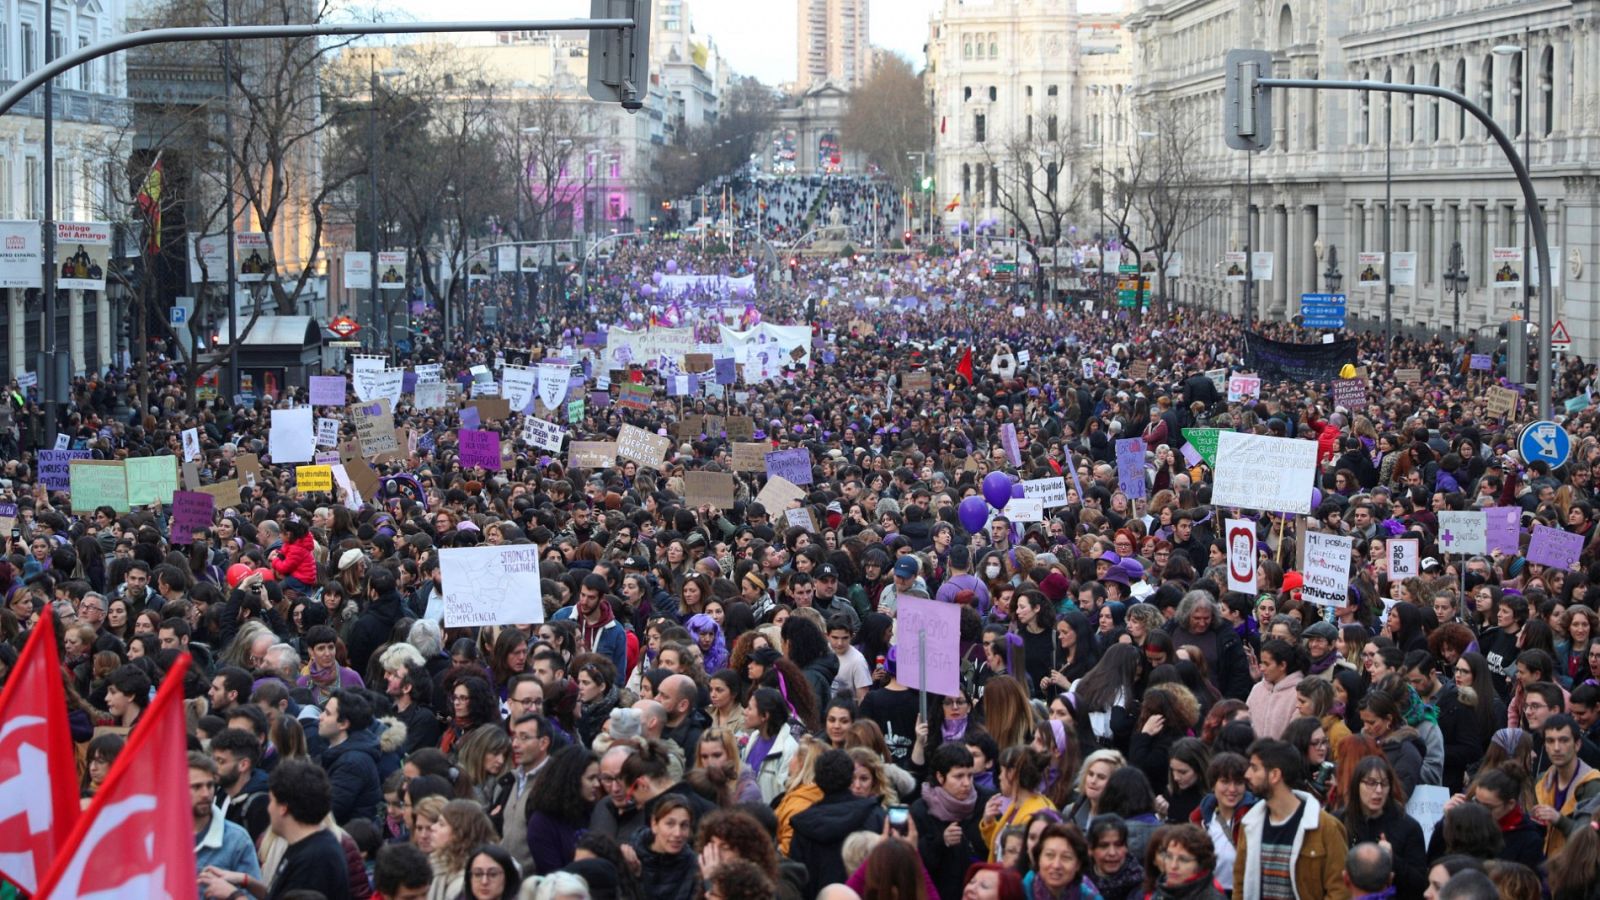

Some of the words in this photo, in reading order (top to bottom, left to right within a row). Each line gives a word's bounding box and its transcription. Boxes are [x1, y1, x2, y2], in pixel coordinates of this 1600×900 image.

[58, 223, 90, 232] Diálogo
[74, 231, 107, 240] Amargo
[174, 308, 185, 322] P
[624, 424, 651, 441] SOMOS
[621, 437, 656, 455] FUERTES
[40, 451, 53, 460] NO
[56, 452, 70, 460] HAY
[766, 453, 777, 463] EL
[41, 463, 61, 473] VIRUS
[1035, 483, 1042, 492] la
[1042, 481, 1064, 494] igualdad:
[1054, 493, 1066, 502] más!
[1324, 539, 1351, 549] postura
[501, 549, 535, 563] STRONGER
[504, 563, 536, 574] TOGETHER
[1311, 575, 1335, 588] ABAJO
[446, 593, 457, 604] NO
[446, 603, 473, 615] SOMOS
[446, 612, 497, 625] COMPETENCIA
